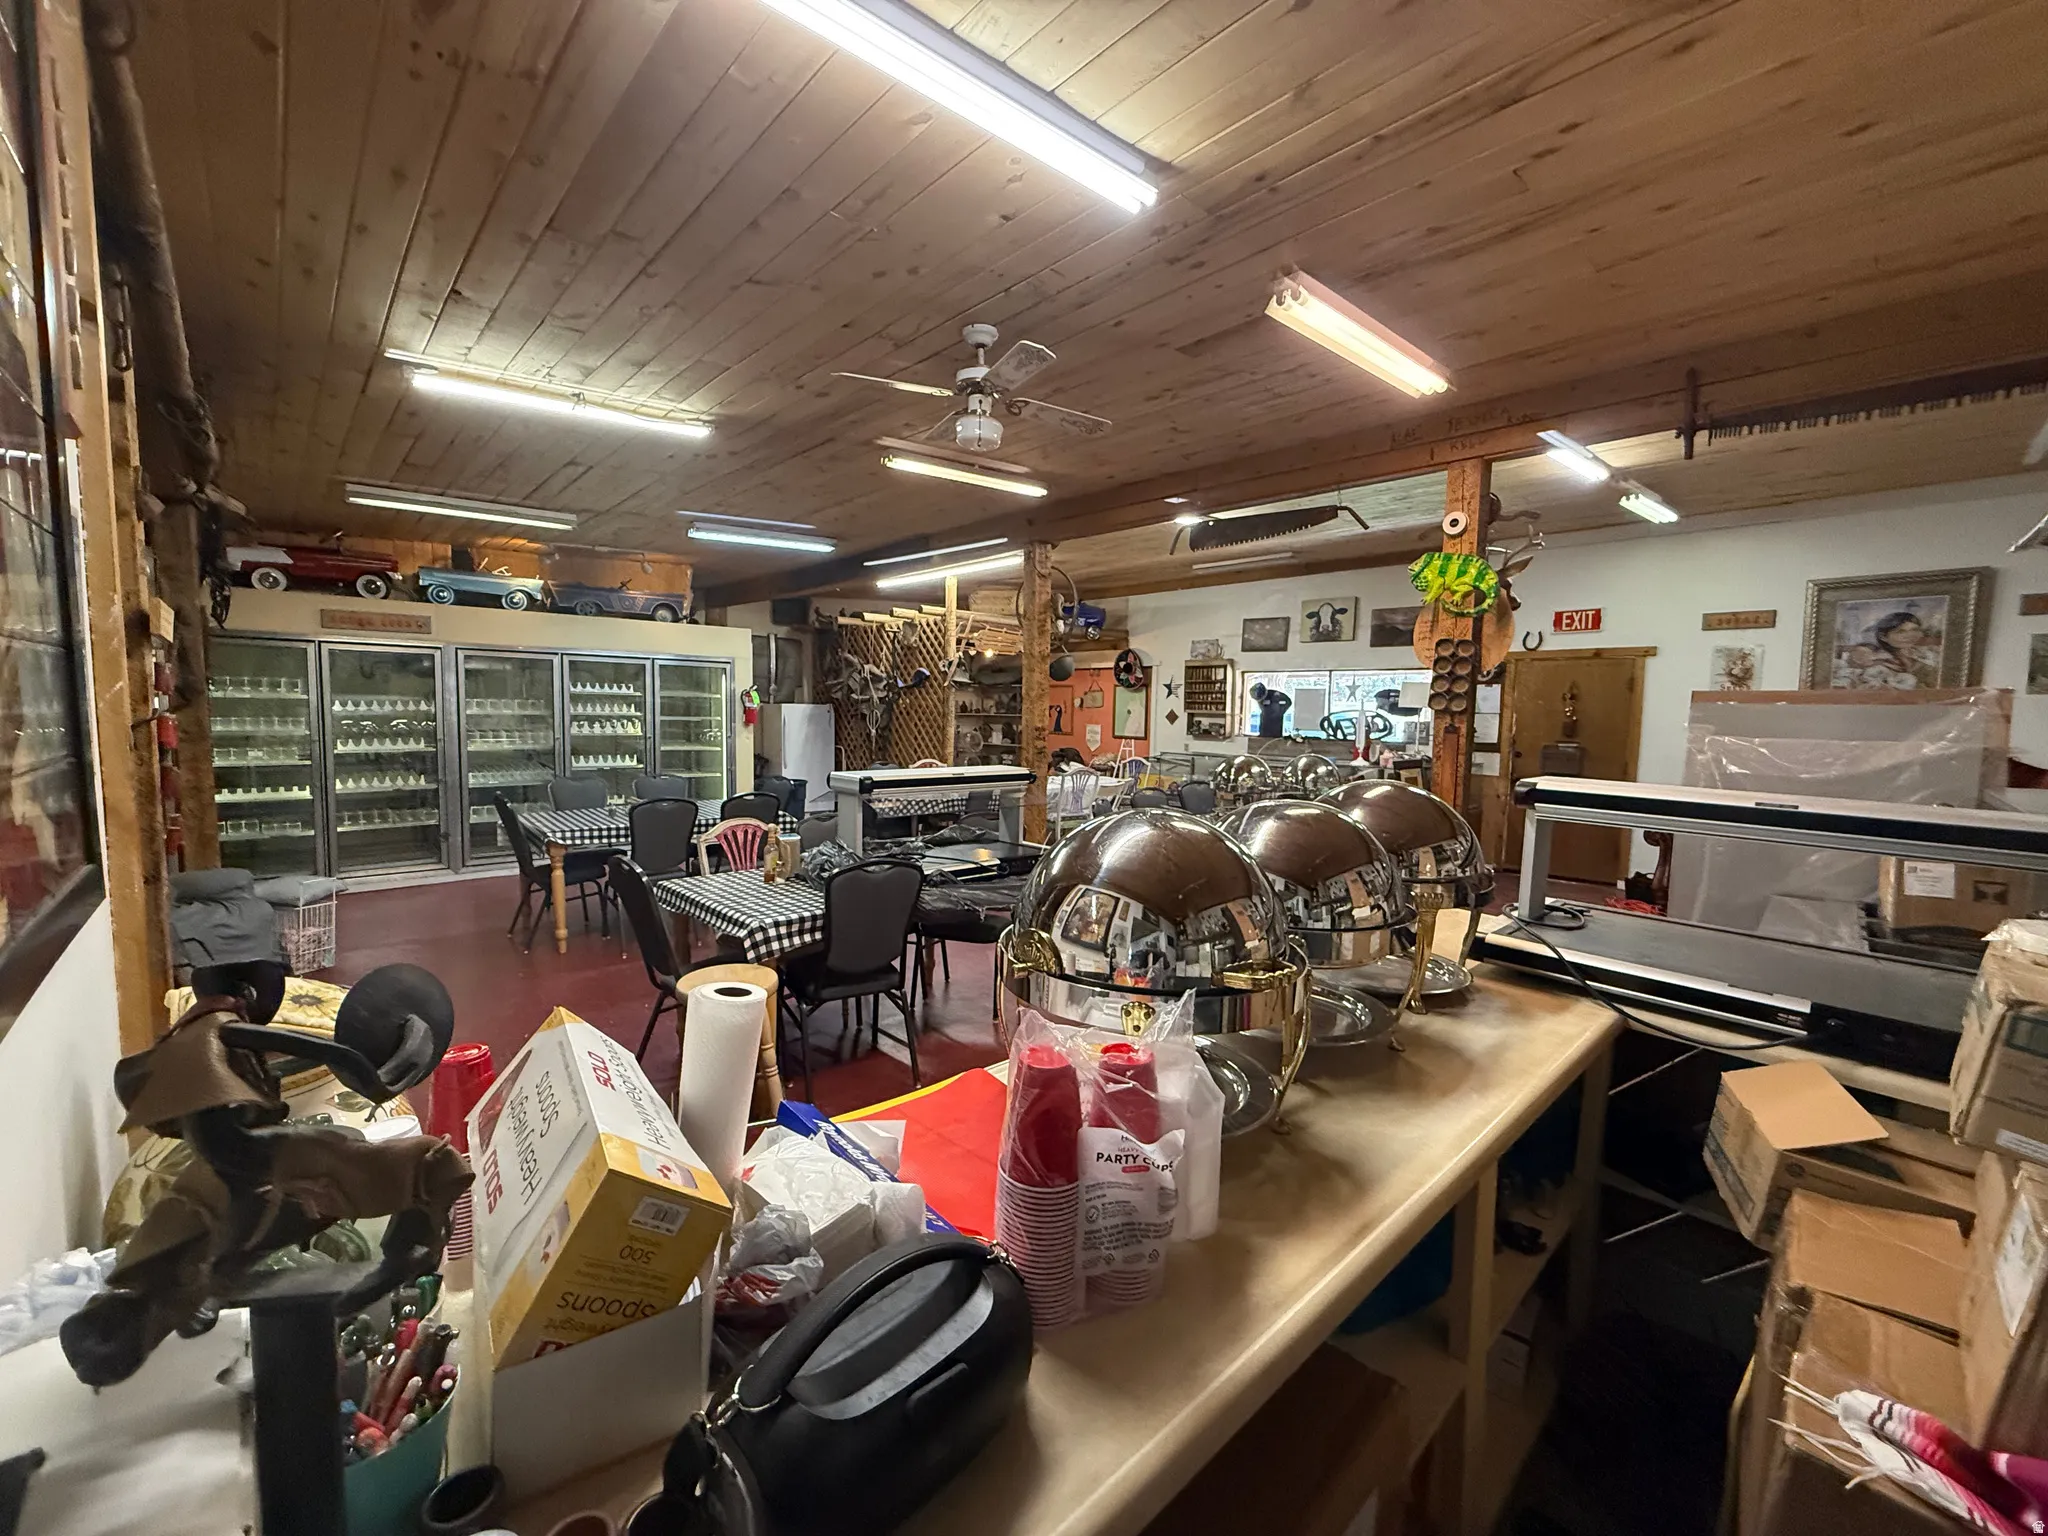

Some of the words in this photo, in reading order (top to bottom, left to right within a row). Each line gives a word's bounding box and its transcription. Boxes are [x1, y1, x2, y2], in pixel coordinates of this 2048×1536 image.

[1562, 611, 1596, 631] EXIT
[587, 1050, 616, 1092] SOLO
[535, 1070, 559, 1139] Spoons
[1096, 1152, 1140, 1165] PARTY
[1143, 1157, 1174, 1172] CUPS
[620, 1245, 656, 1265] 500
